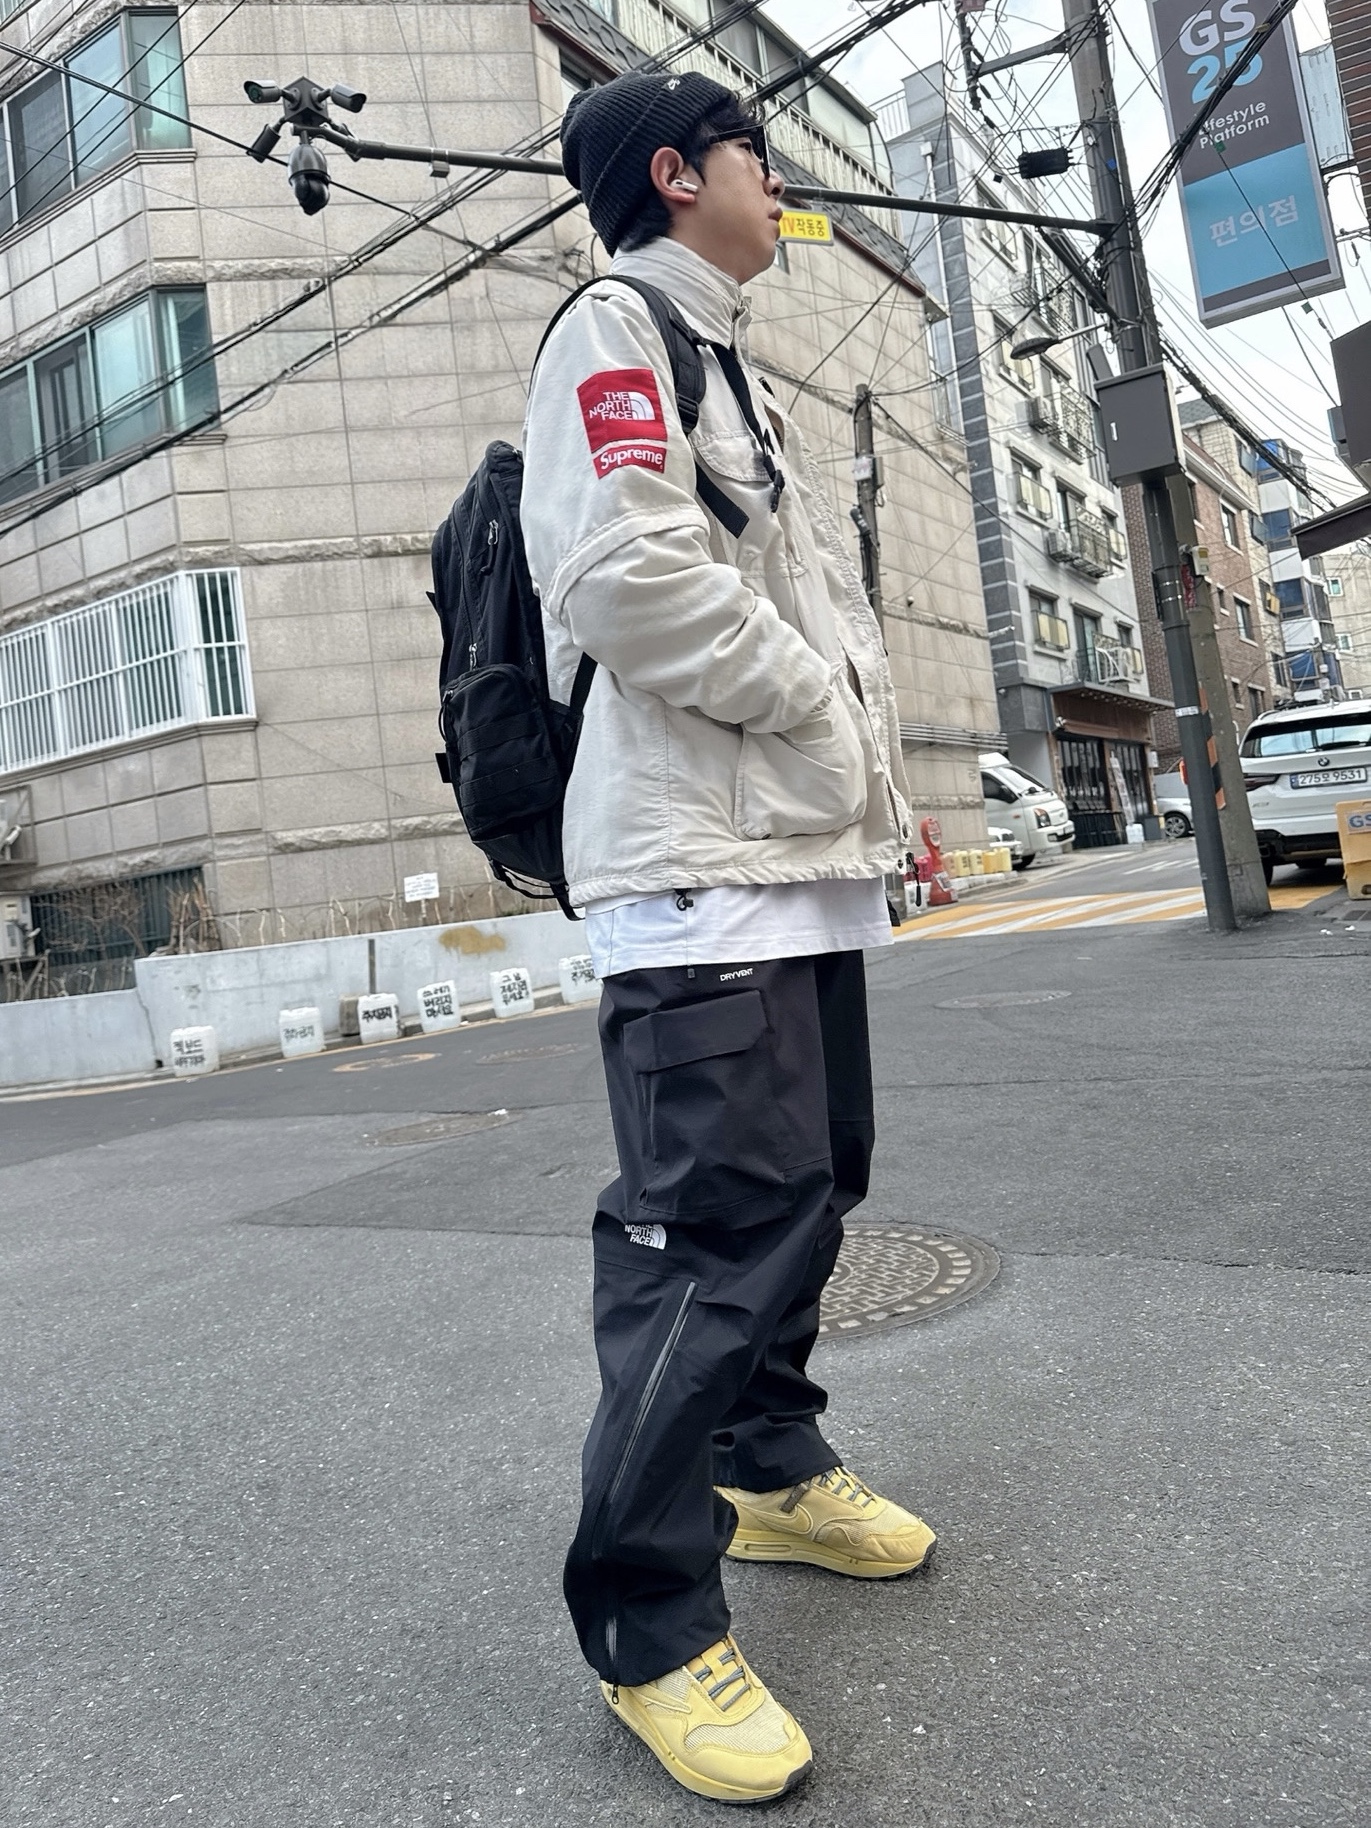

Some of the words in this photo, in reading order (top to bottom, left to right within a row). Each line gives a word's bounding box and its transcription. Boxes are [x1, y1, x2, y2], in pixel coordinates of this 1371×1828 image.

[1179, 0, 1257, 56] GS
[1199, 115, 1271, 149] Platform
[1209, 195, 1300, 248] 편의점
[603, 391, 630, 401] THE
[589, 400, 632, 419] NORTH
[601, 410, 633, 421] FACE
[600, 449, 664, 470] Supreme
[1332, 769, 1362, 782] 9531
[720, 968, 753, 981] DRYVENT
[624, 1224, 653, 1238] NORTH
[629, 1233, 652, 1247] FACE
